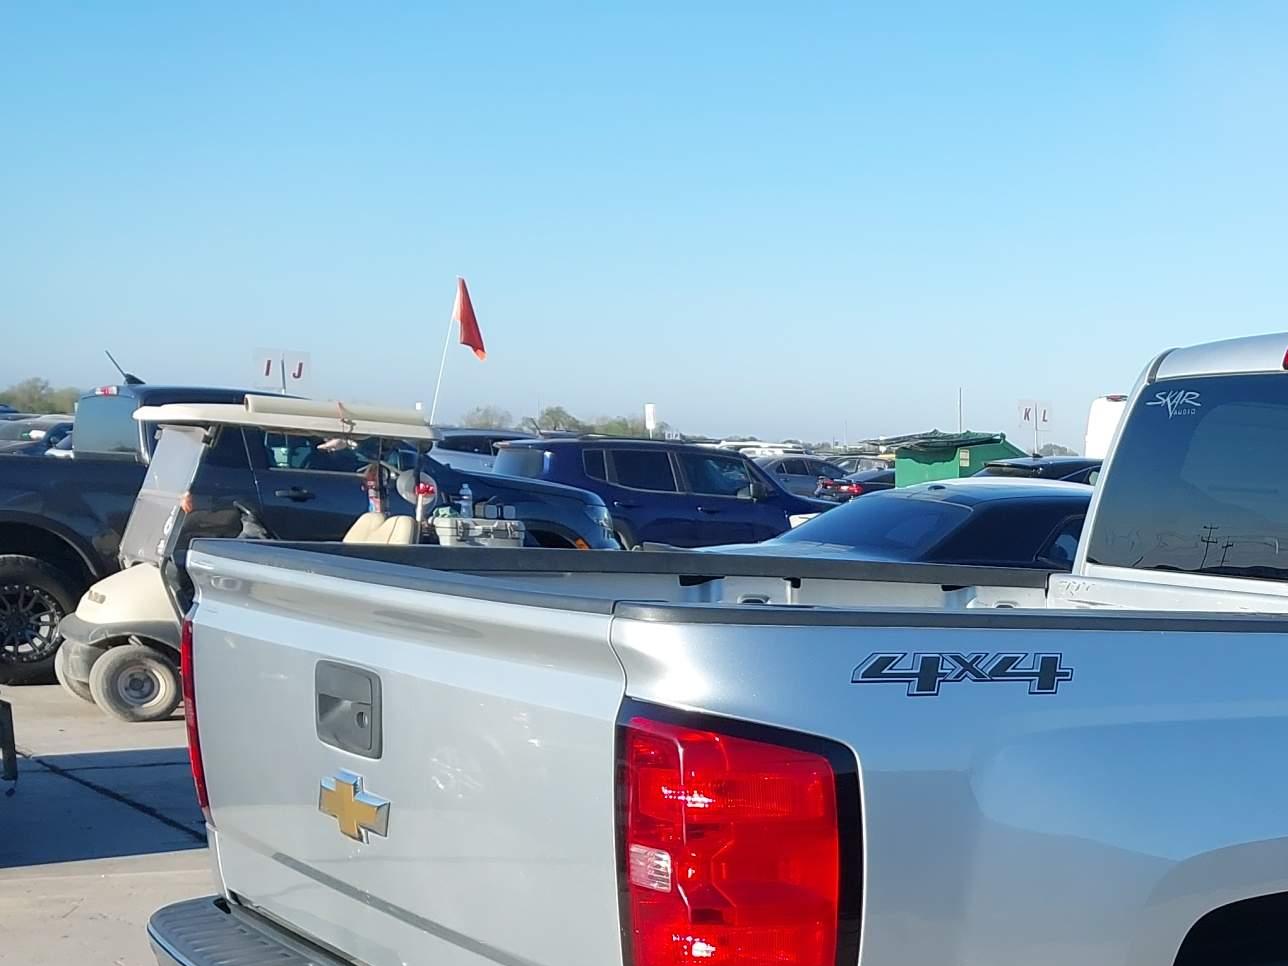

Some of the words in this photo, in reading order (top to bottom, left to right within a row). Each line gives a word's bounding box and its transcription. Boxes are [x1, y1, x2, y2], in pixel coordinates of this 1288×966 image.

[292, 361, 304, 379] J
[1145, 389, 1202, 420] SKAR
[1023, 407, 1032, 421] K
[1042, 409, 1049, 422] L
[1173, 408, 1196, 416] AUDIO
